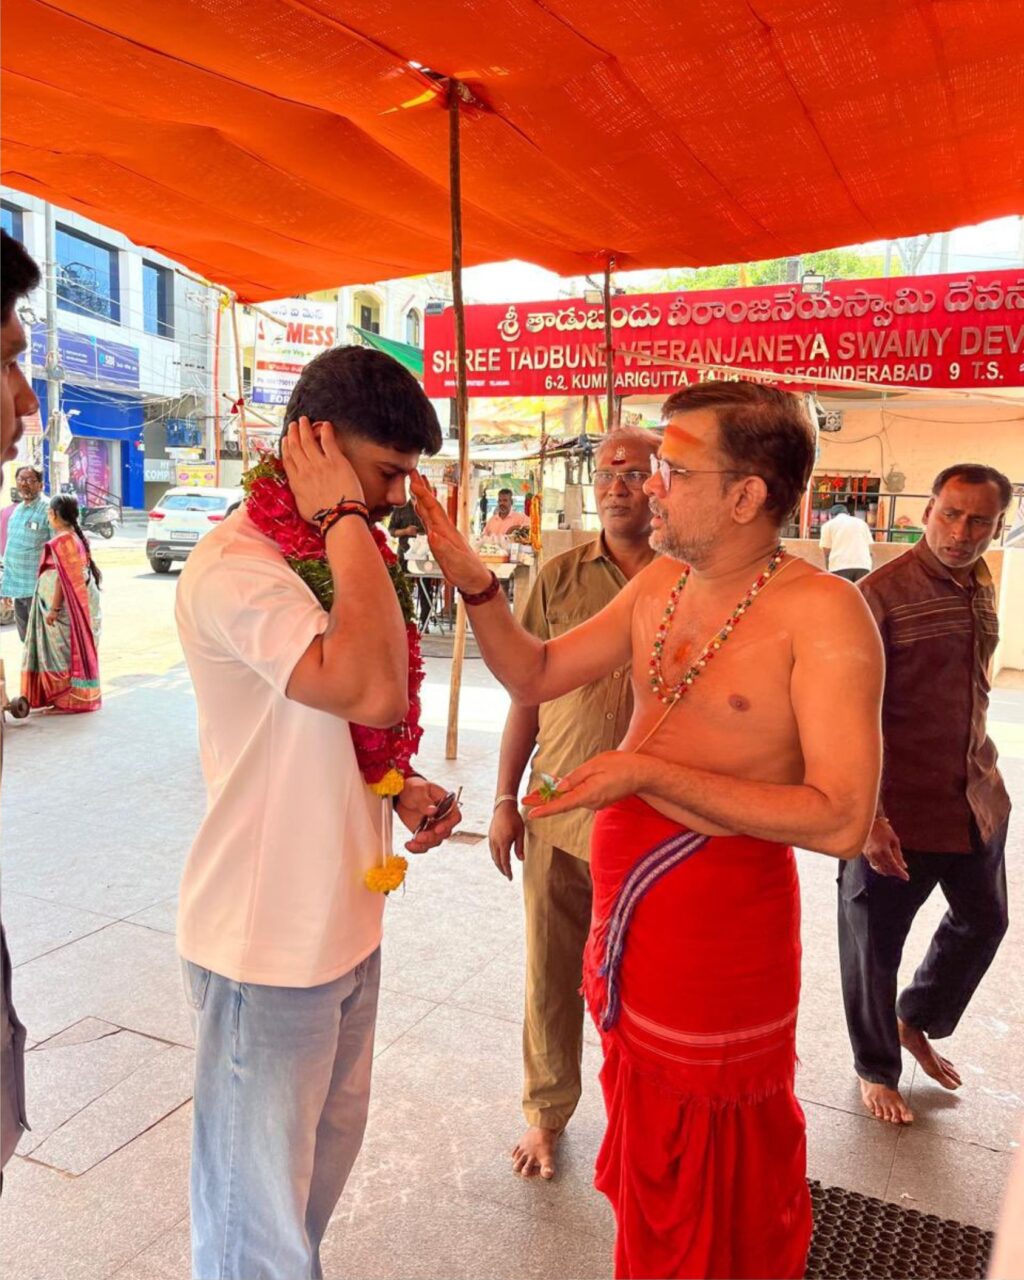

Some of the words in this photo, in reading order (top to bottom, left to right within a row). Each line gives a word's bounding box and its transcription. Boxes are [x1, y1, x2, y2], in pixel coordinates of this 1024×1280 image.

[286, 322, 334, 347] MESS
[497, 305, 521, 342] శ్రీ
[432, 348, 501, 374] SHREE
[619, 333, 830, 367] VEERANJANEYA
[838, 327, 952, 361] SWAMY
[784, 363, 933, 384] SECUNDERABAD
[949, 362, 960, 380] 9
